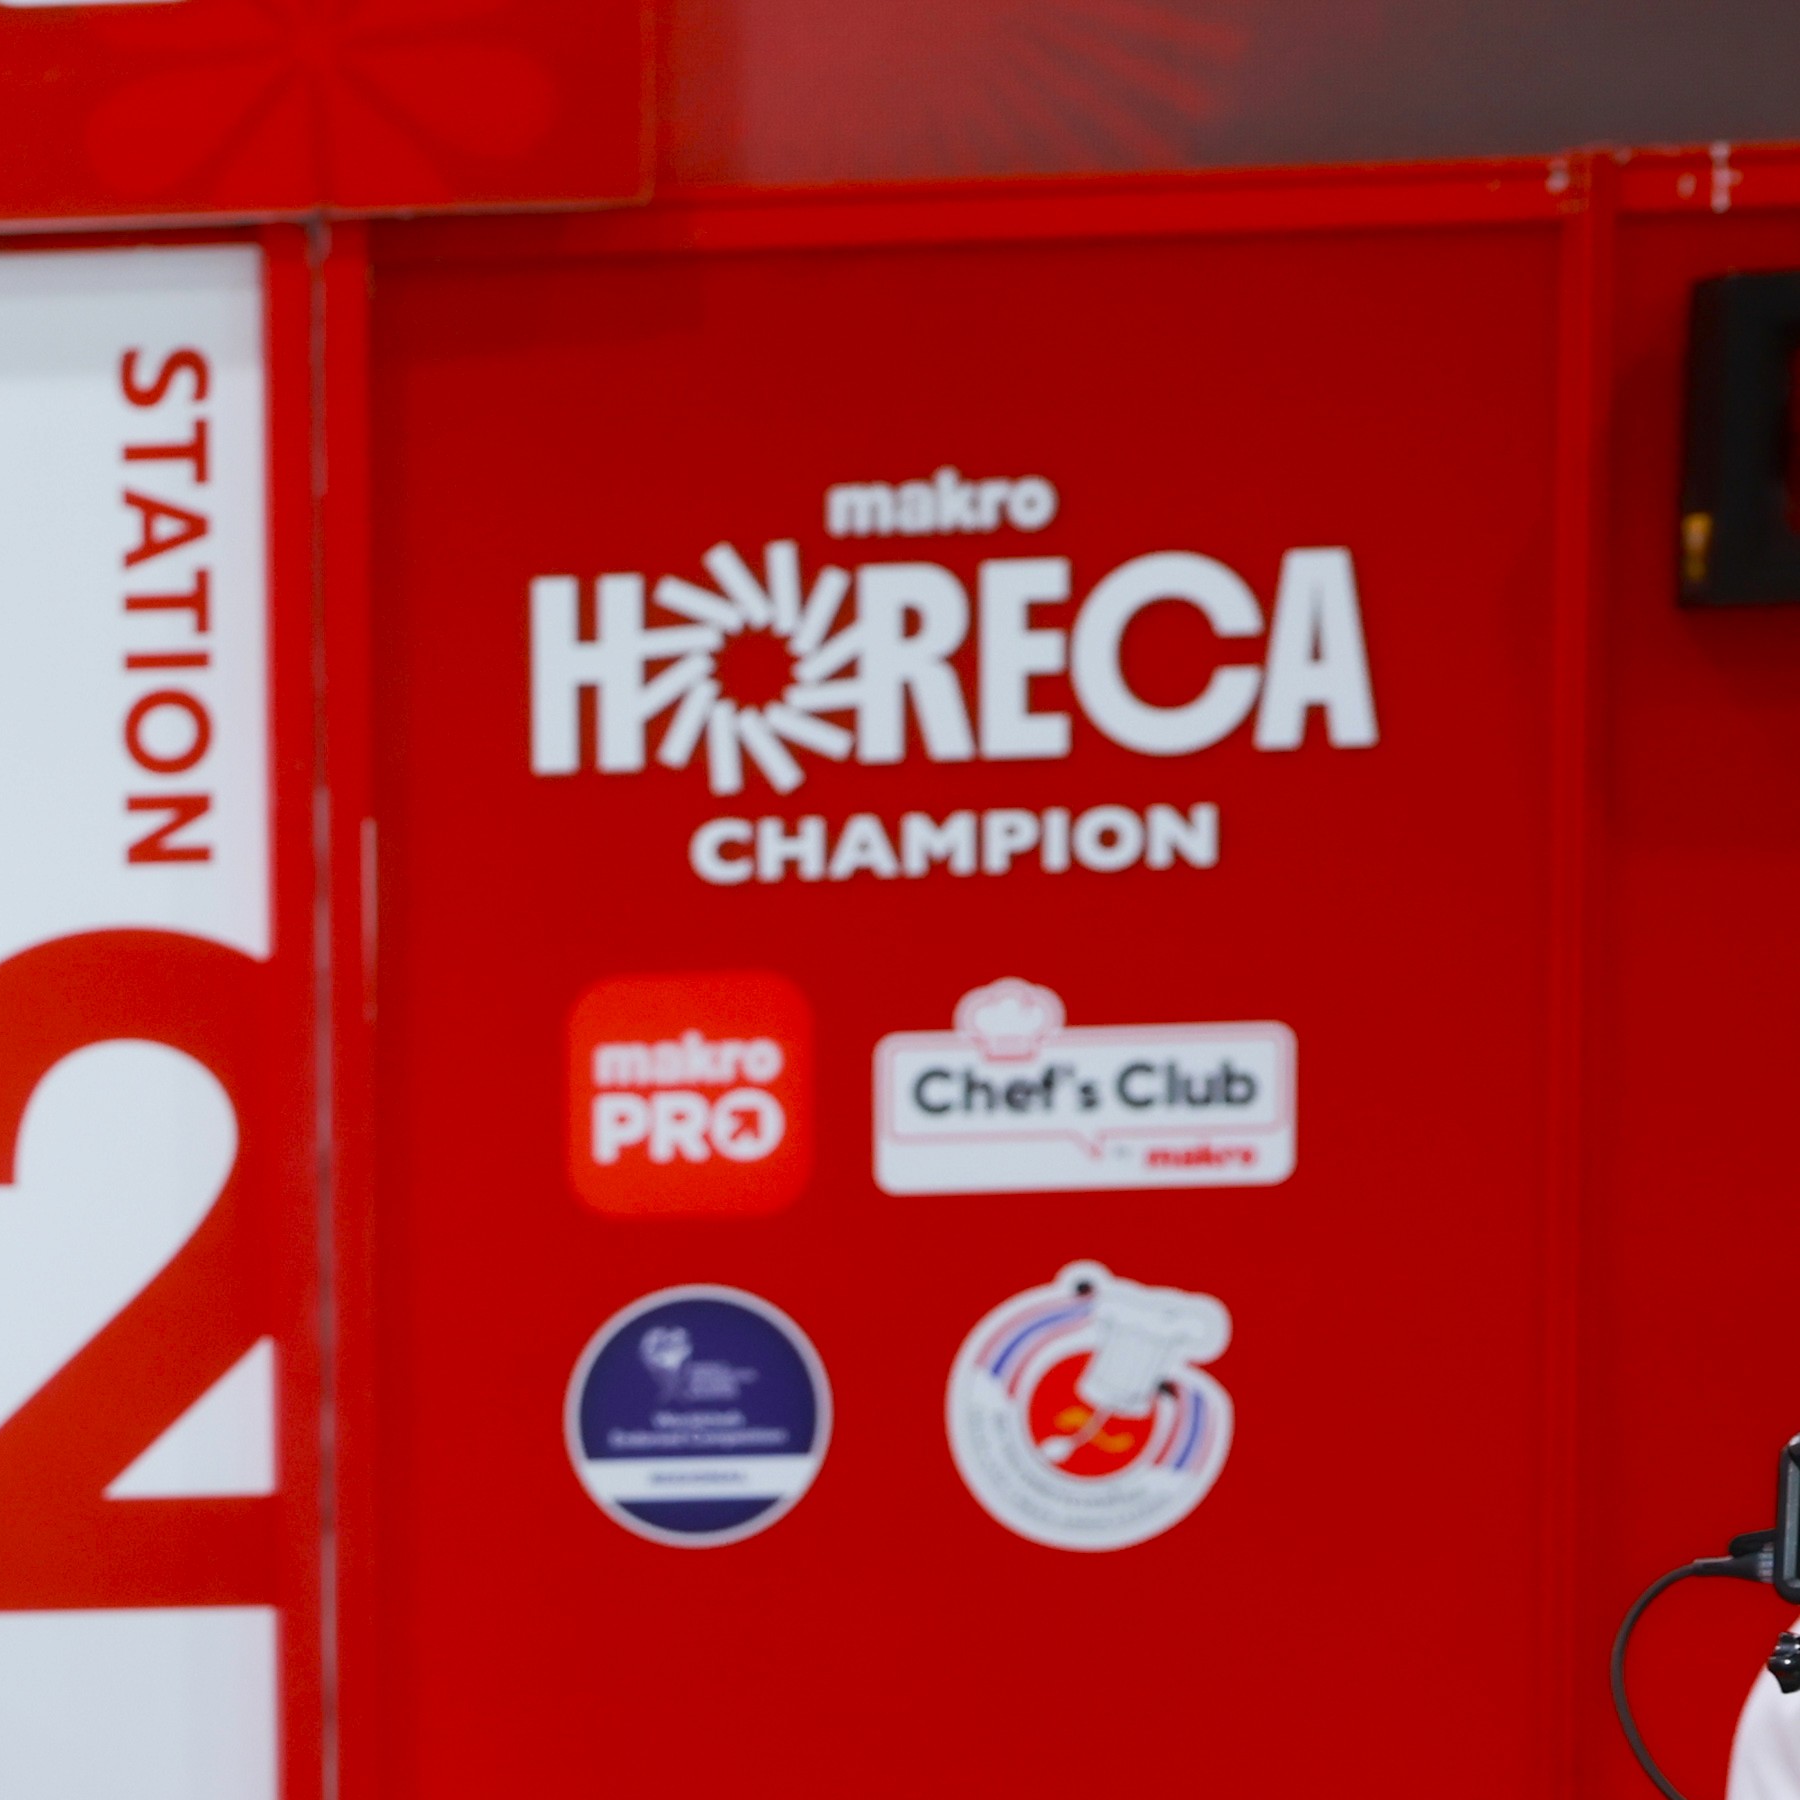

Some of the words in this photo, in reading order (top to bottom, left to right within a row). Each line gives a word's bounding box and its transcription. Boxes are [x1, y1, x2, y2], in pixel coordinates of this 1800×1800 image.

[827, 467, 1058, 537] makro
[120, 346, 213, 864] STATION
[688, 803, 1220, 885] CHAMPION
[593, 1031, 783, 1085] makro
[913, 1065, 1098, 1117] Chef's
[1117, 1060, 1258, 1109] Club
[593, 1089, 784, 1163] PRO
